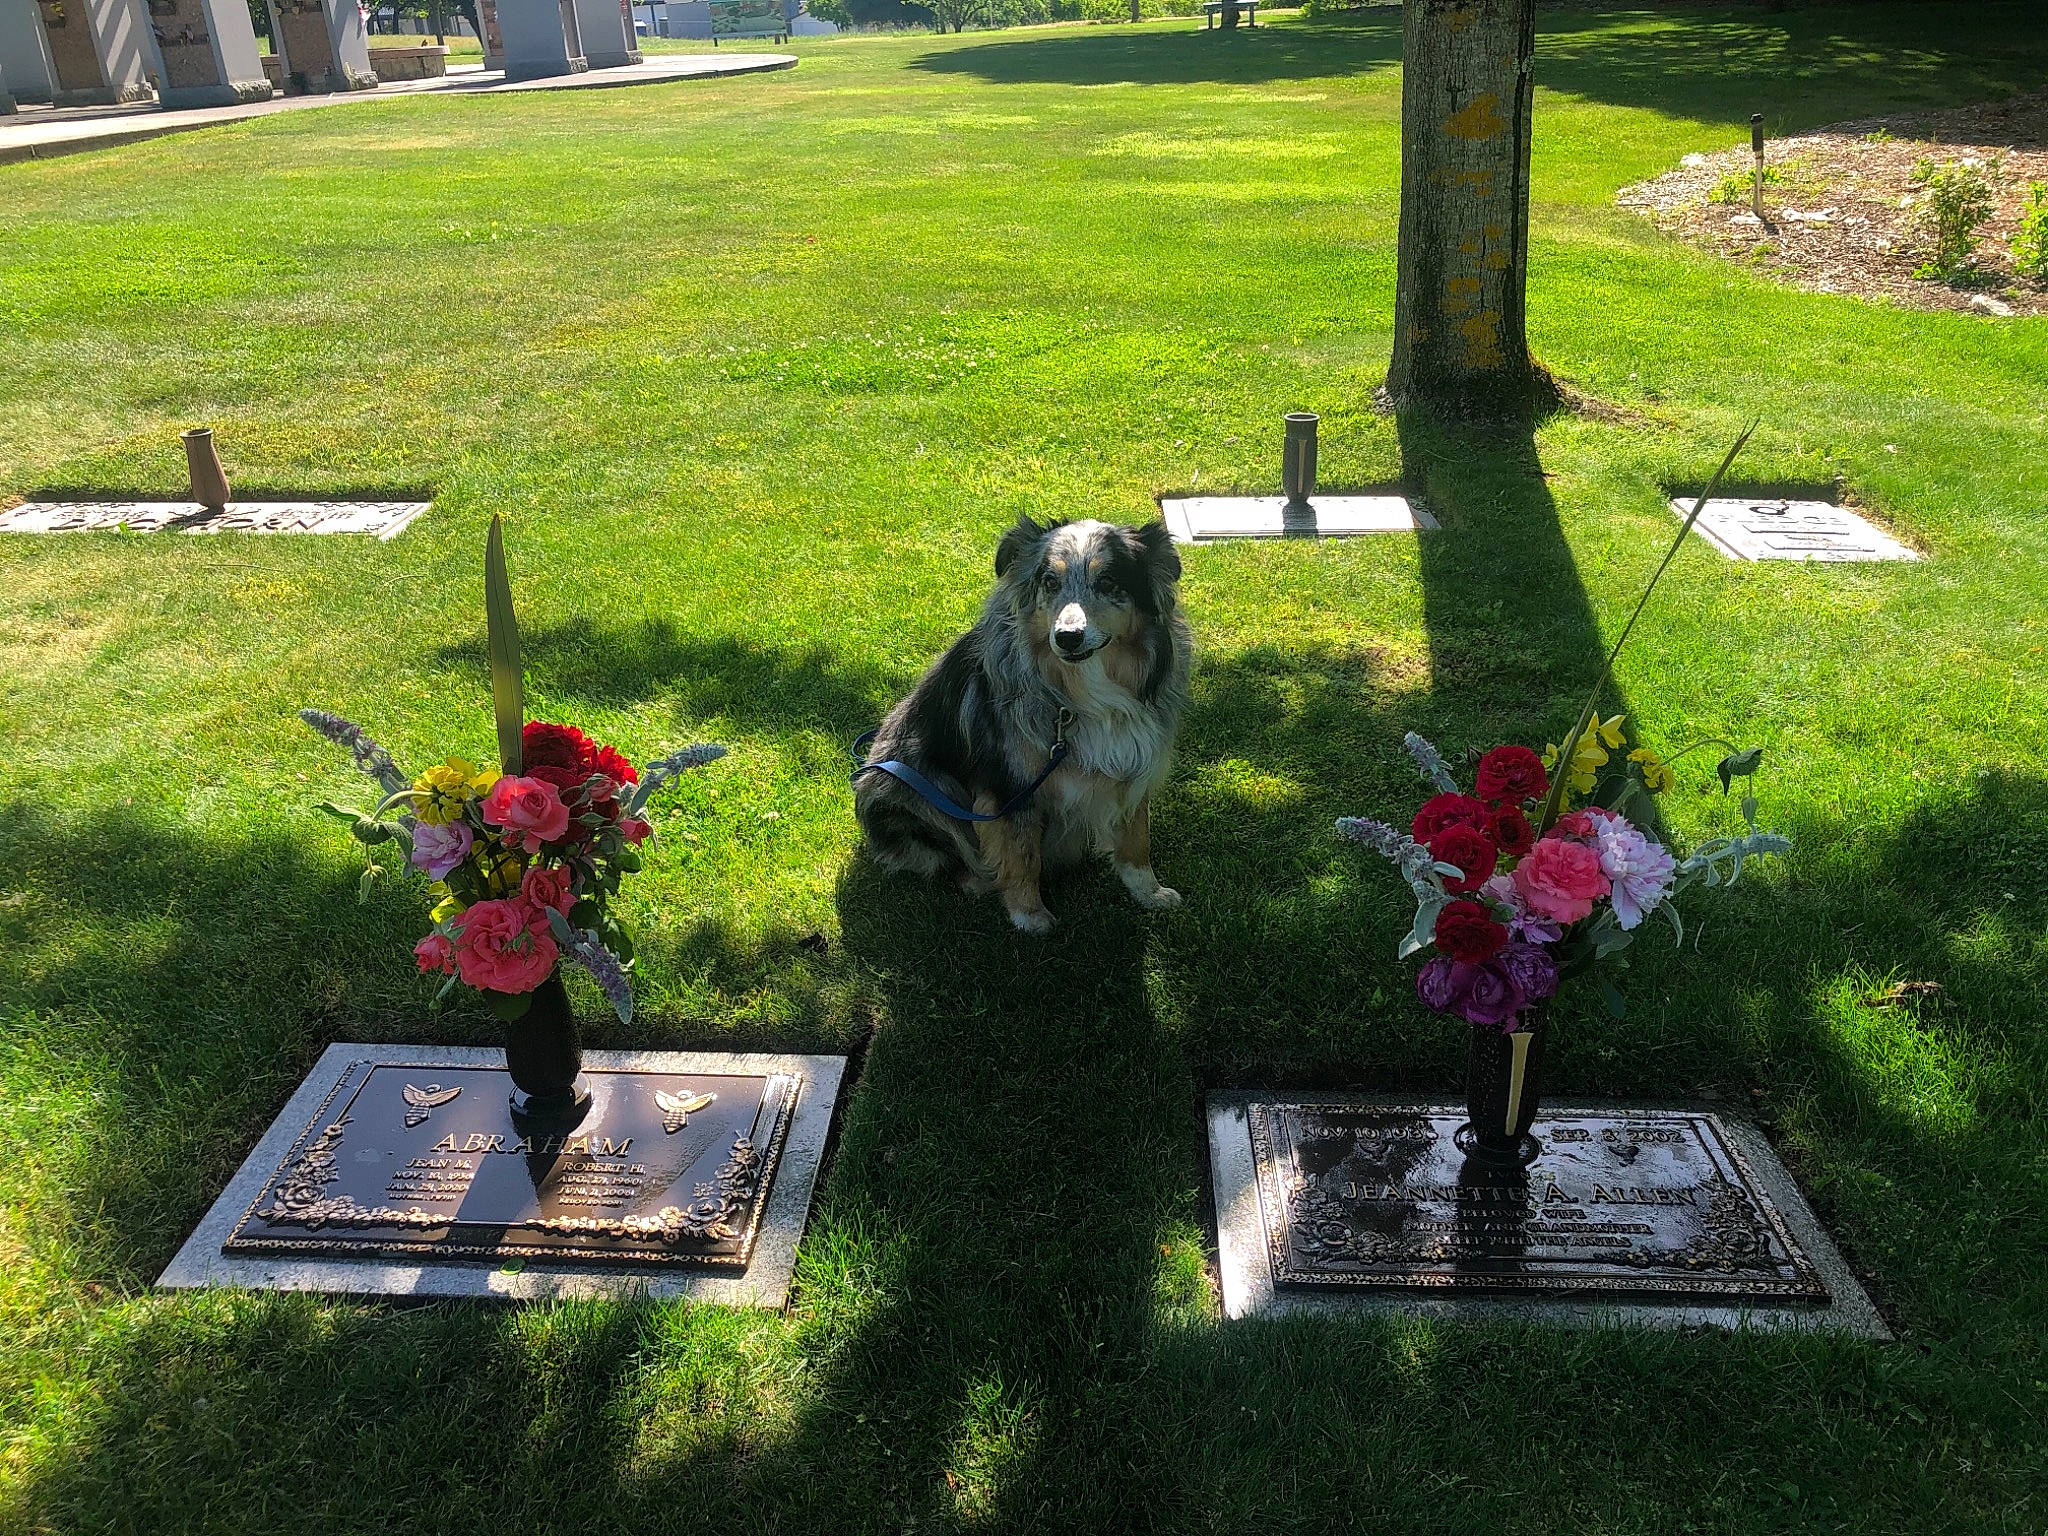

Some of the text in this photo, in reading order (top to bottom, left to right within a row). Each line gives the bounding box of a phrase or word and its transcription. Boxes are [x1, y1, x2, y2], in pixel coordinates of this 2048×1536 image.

[1551, 1128, 1593, 1143] SEP.
[1626, 1128, 1686, 1143] 2002
[430, 1131, 635, 1157] ABRAHAM
[405, 1157, 452, 1169] JEAN
[561, 1161, 627, 1173] ROBERT
[392, 1170, 425, 1180] NOV.
[1341, 1180, 1697, 1206] JEANNETTE A. ALLEN
[1462, 1208, 1587, 1219] BELOVED WIFE
[1407, 1221, 1653, 1234] MOTHER AND GRANDMOTHER
